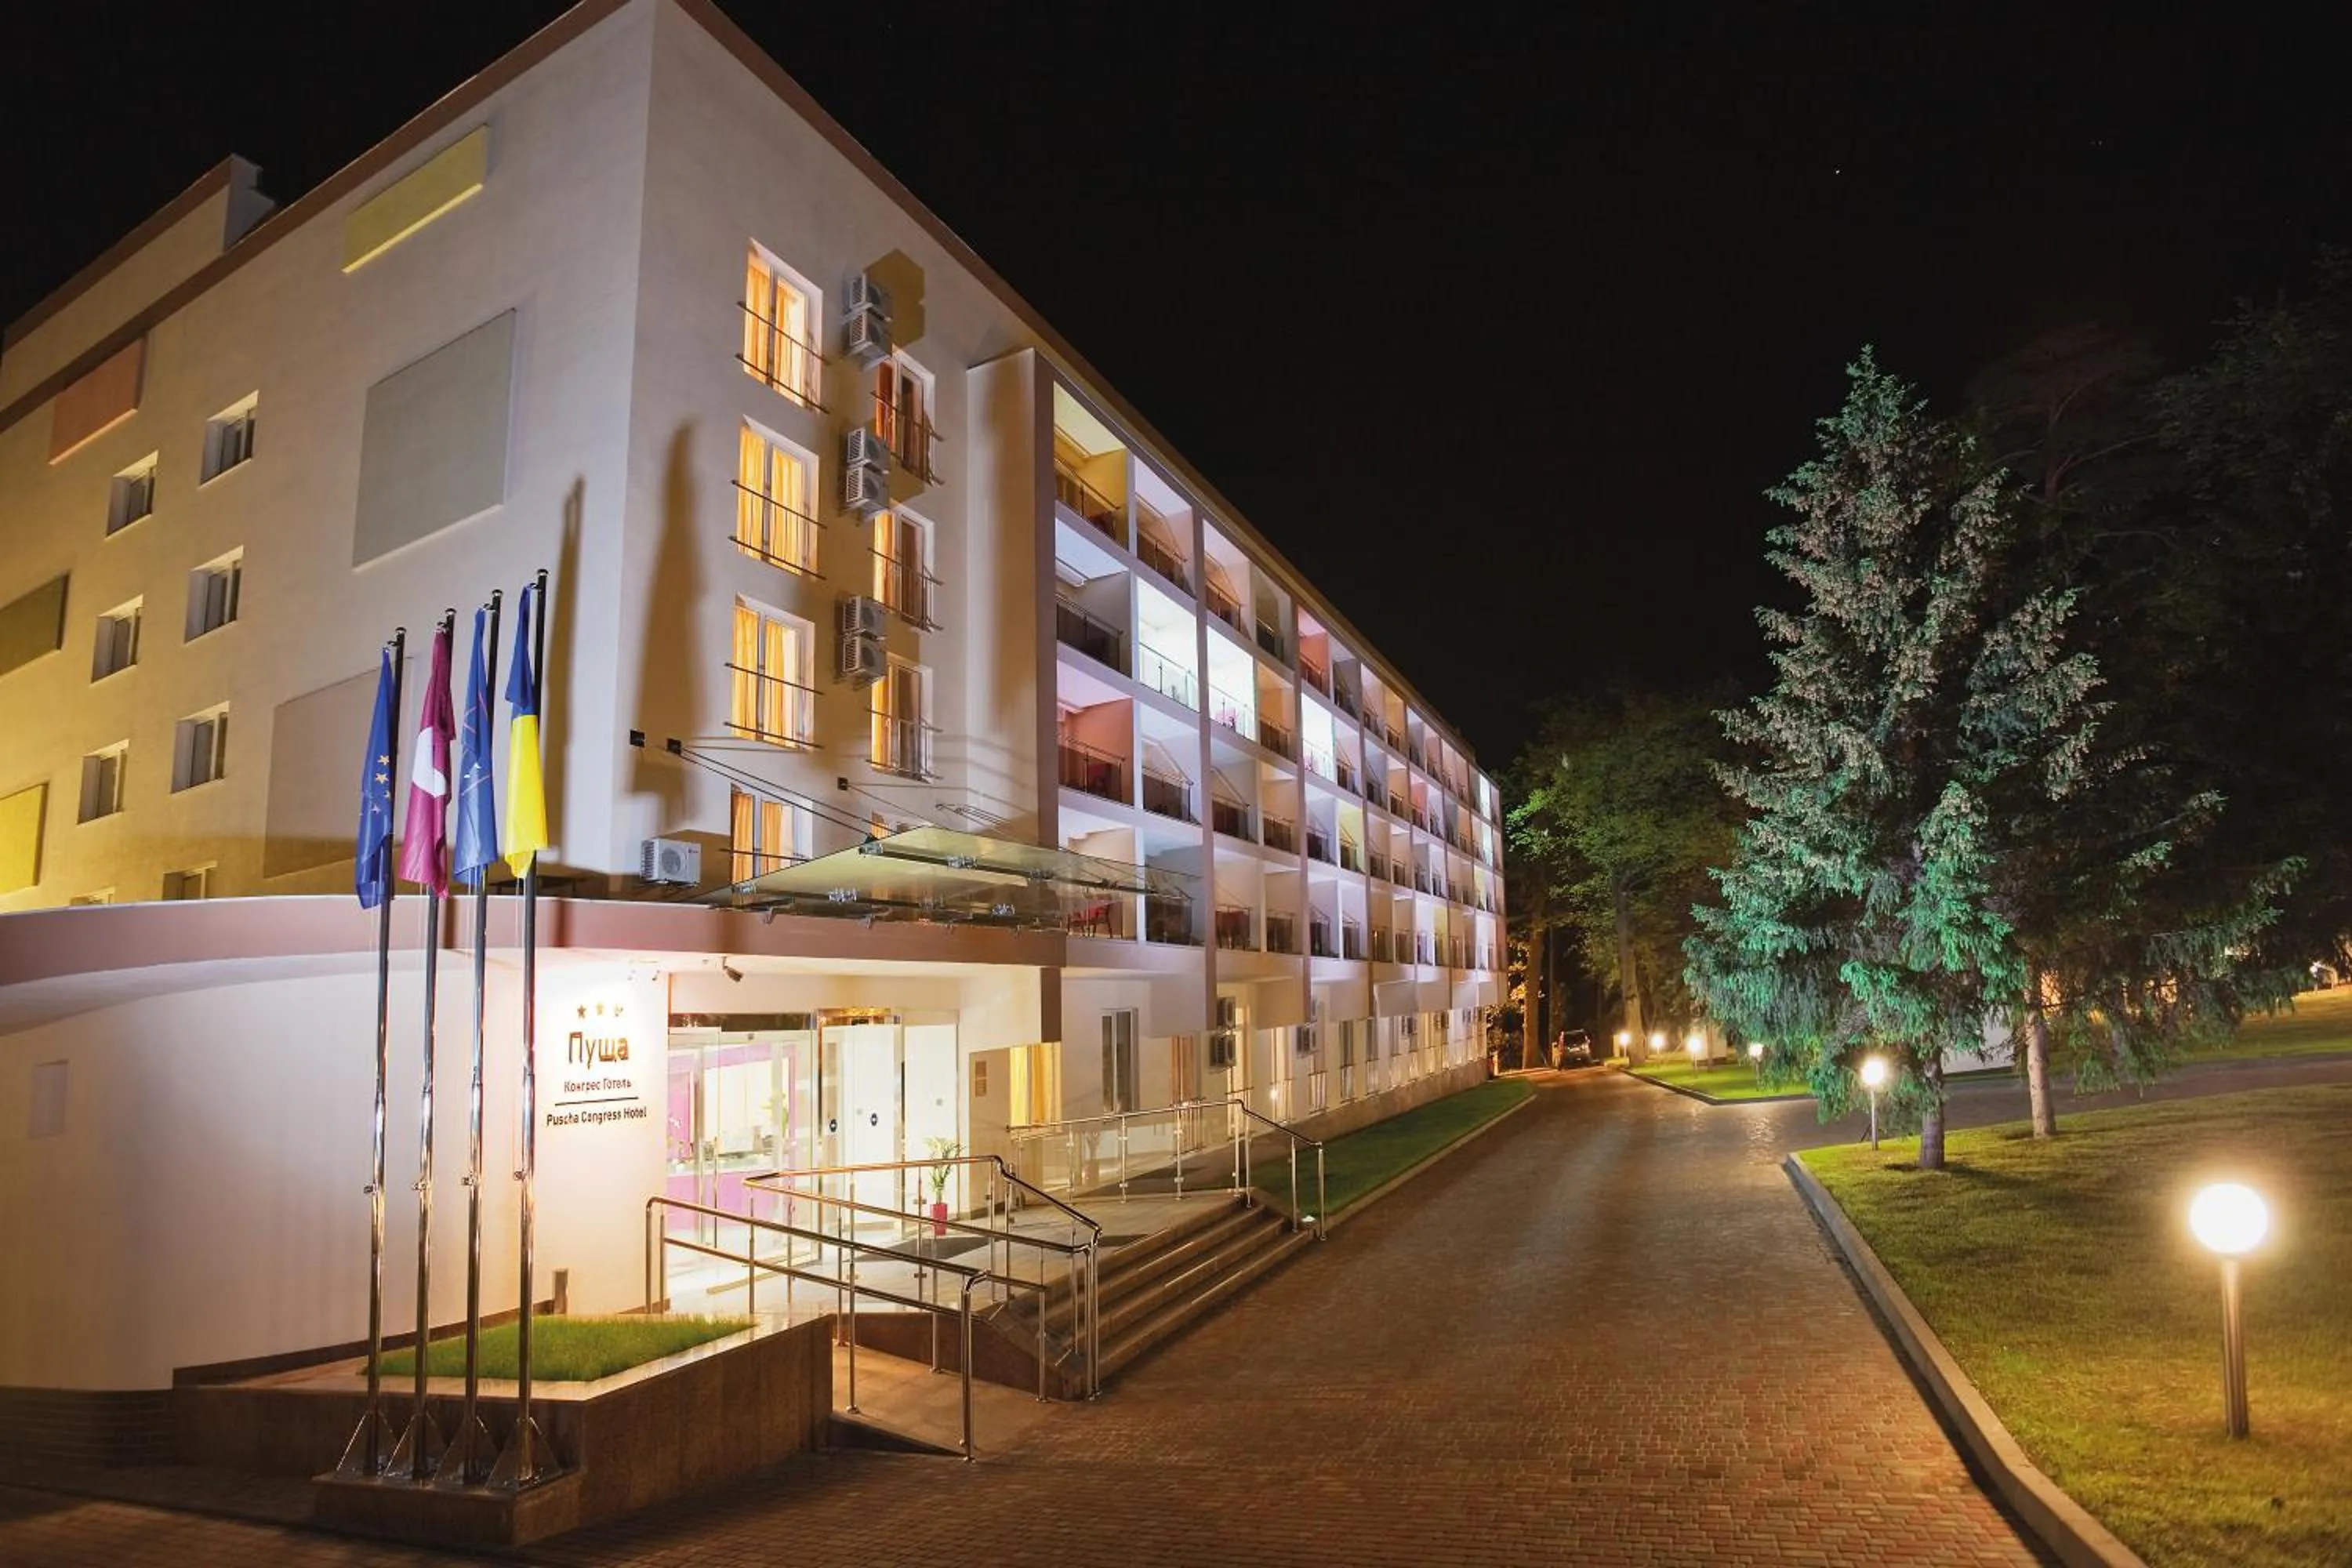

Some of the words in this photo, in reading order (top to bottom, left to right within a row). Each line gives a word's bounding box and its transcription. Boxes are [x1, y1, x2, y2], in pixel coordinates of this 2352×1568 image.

[569, 1032, 628, 1069] Пуща
[564, 1080, 601, 1093] Конгрес
[603, 1078, 632, 1090] Готель
[546, 1113, 579, 1127] Puscha
[581, 1109, 622, 1124] Congress
[623, 1106, 647, 1119] Hotel
